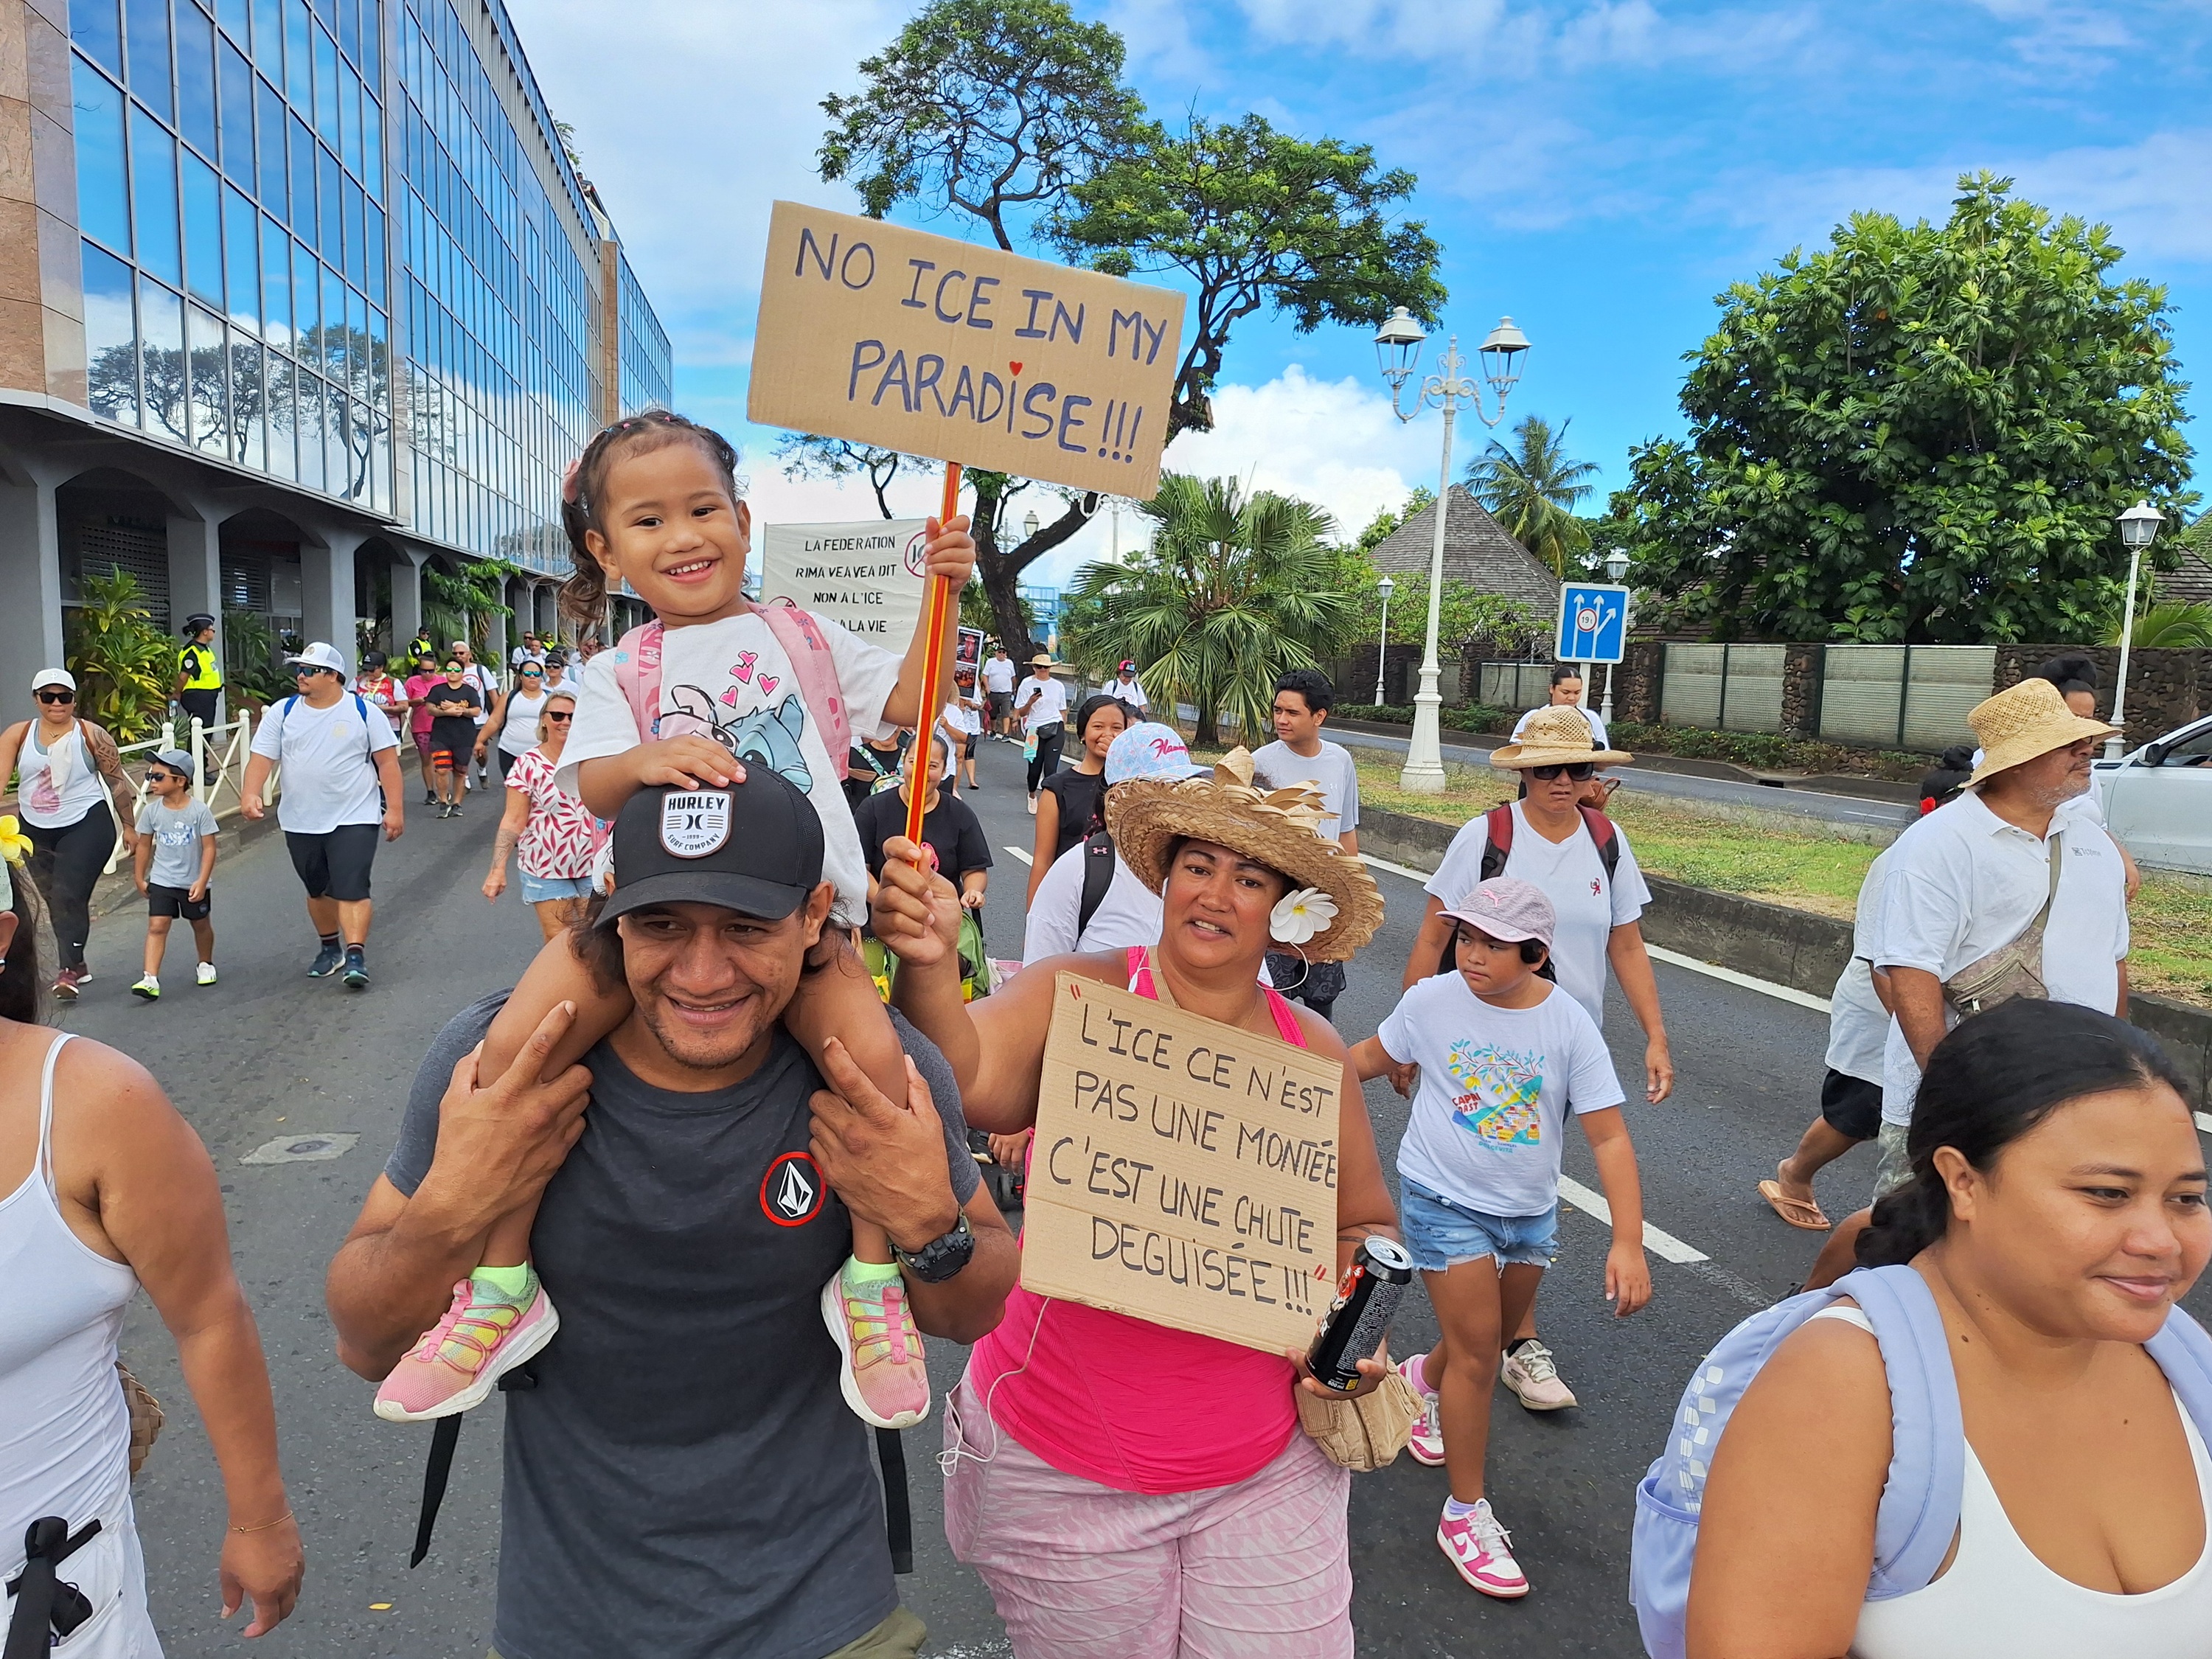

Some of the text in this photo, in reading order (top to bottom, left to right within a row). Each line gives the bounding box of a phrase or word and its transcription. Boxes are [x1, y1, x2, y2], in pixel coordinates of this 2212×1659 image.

[796, 228, 1167, 365] NO ICE IN MY
[805, 535, 895, 552] LA FEDERATION
[796, 567, 825, 578] RIMA
[879, 564, 897, 577] DIT
[813, 592, 883, 604] NON A L'ICE
[868, 620, 887, 633] VIE
[668, 796, 725, 810] HURLEY
[667, 833, 720, 850] SURF COMPANY
[1186, 1047, 1236, 1088] CE
[1248, 1065, 1333, 1118] N'EST
[1452, 1092, 1481, 1106] CAPRI
[1075, 1071, 1337, 1188] PAS UNE MONTÉE
[1050, 1136, 1314, 1254] C'EST UNE CHUTE
